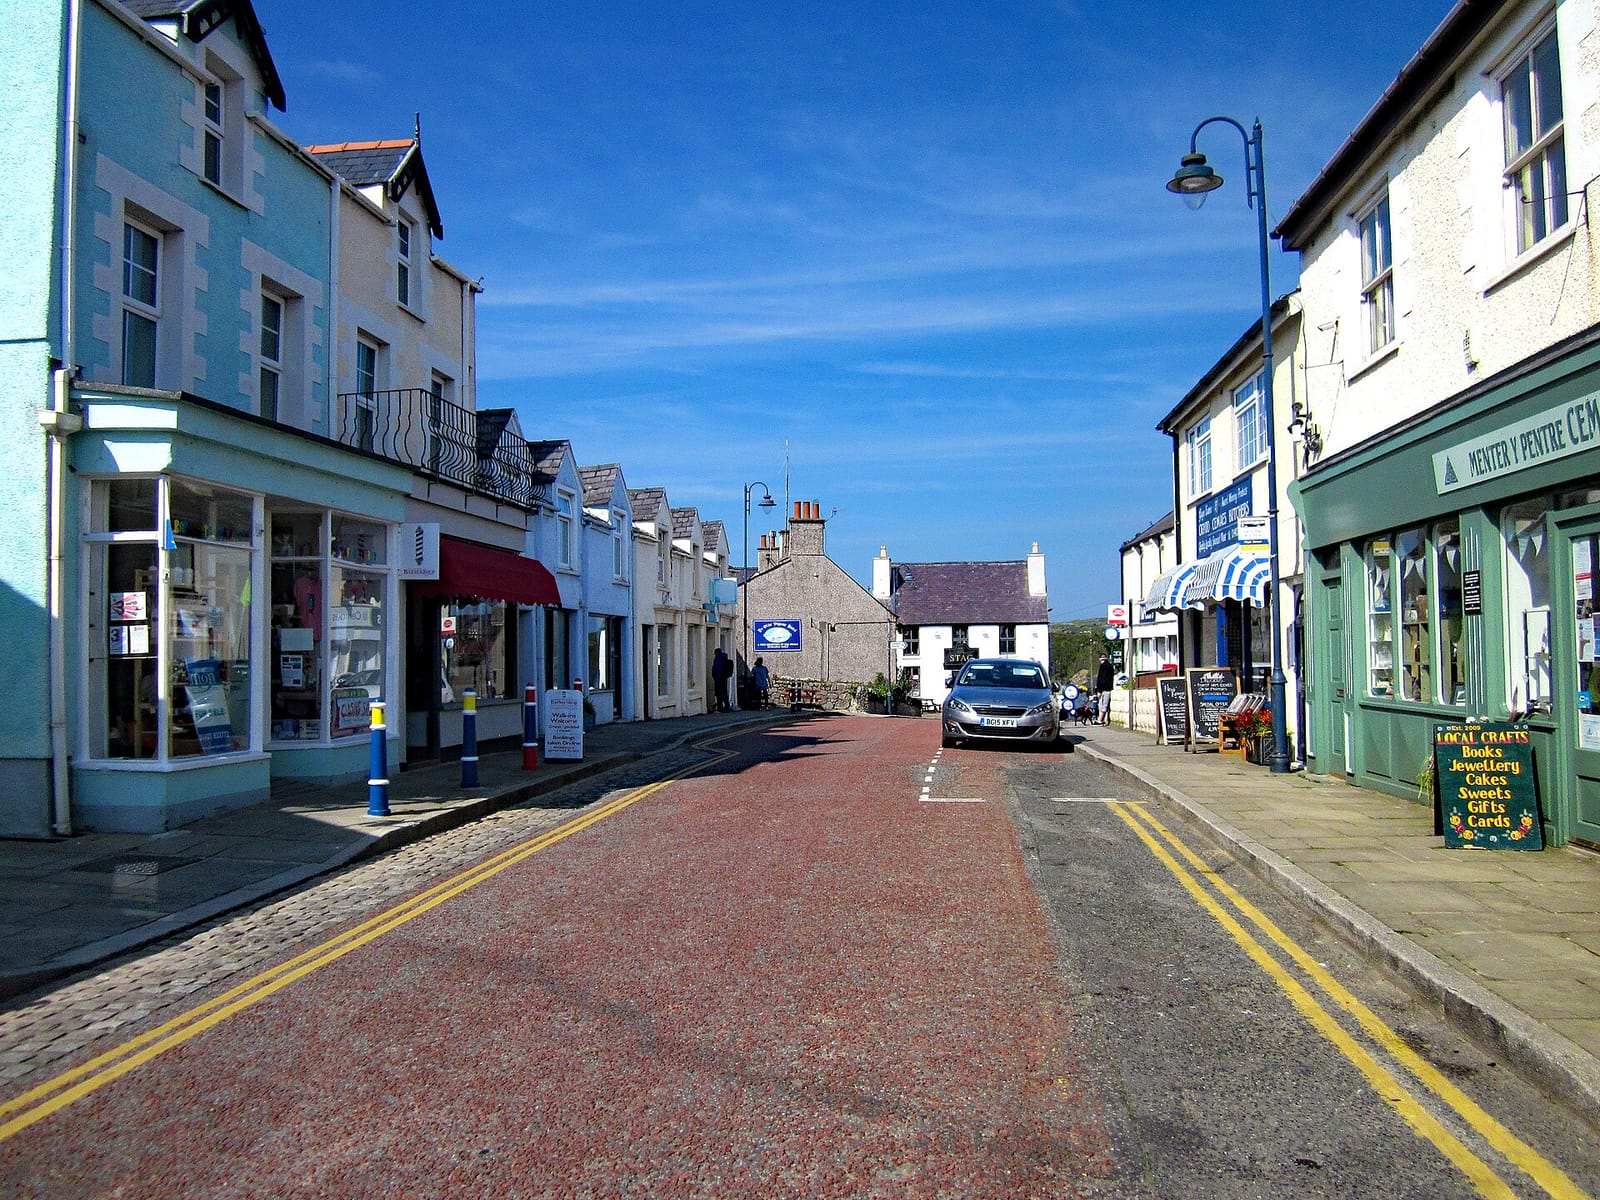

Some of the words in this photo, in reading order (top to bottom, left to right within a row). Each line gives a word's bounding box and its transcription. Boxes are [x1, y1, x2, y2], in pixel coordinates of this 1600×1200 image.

[1468, 440, 1511, 478] MENTER
[1510, 436, 1518, 464] Y
[1520, 419, 1566, 461] PENTRE
[1436, 731, 1478, 745] LOCAL
[1480, 731, 1530, 744] CRAFTS
[1462, 745, 1503, 758] Books
[1449, 759, 1521, 775] Jewellery
[1465, 773, 1508, 786] Cakes
[1457, 786, 1513, 800] Sweets
[1467, 800, 1506, 814] Gifts
[1467, 814, 1511, 828] Cards
